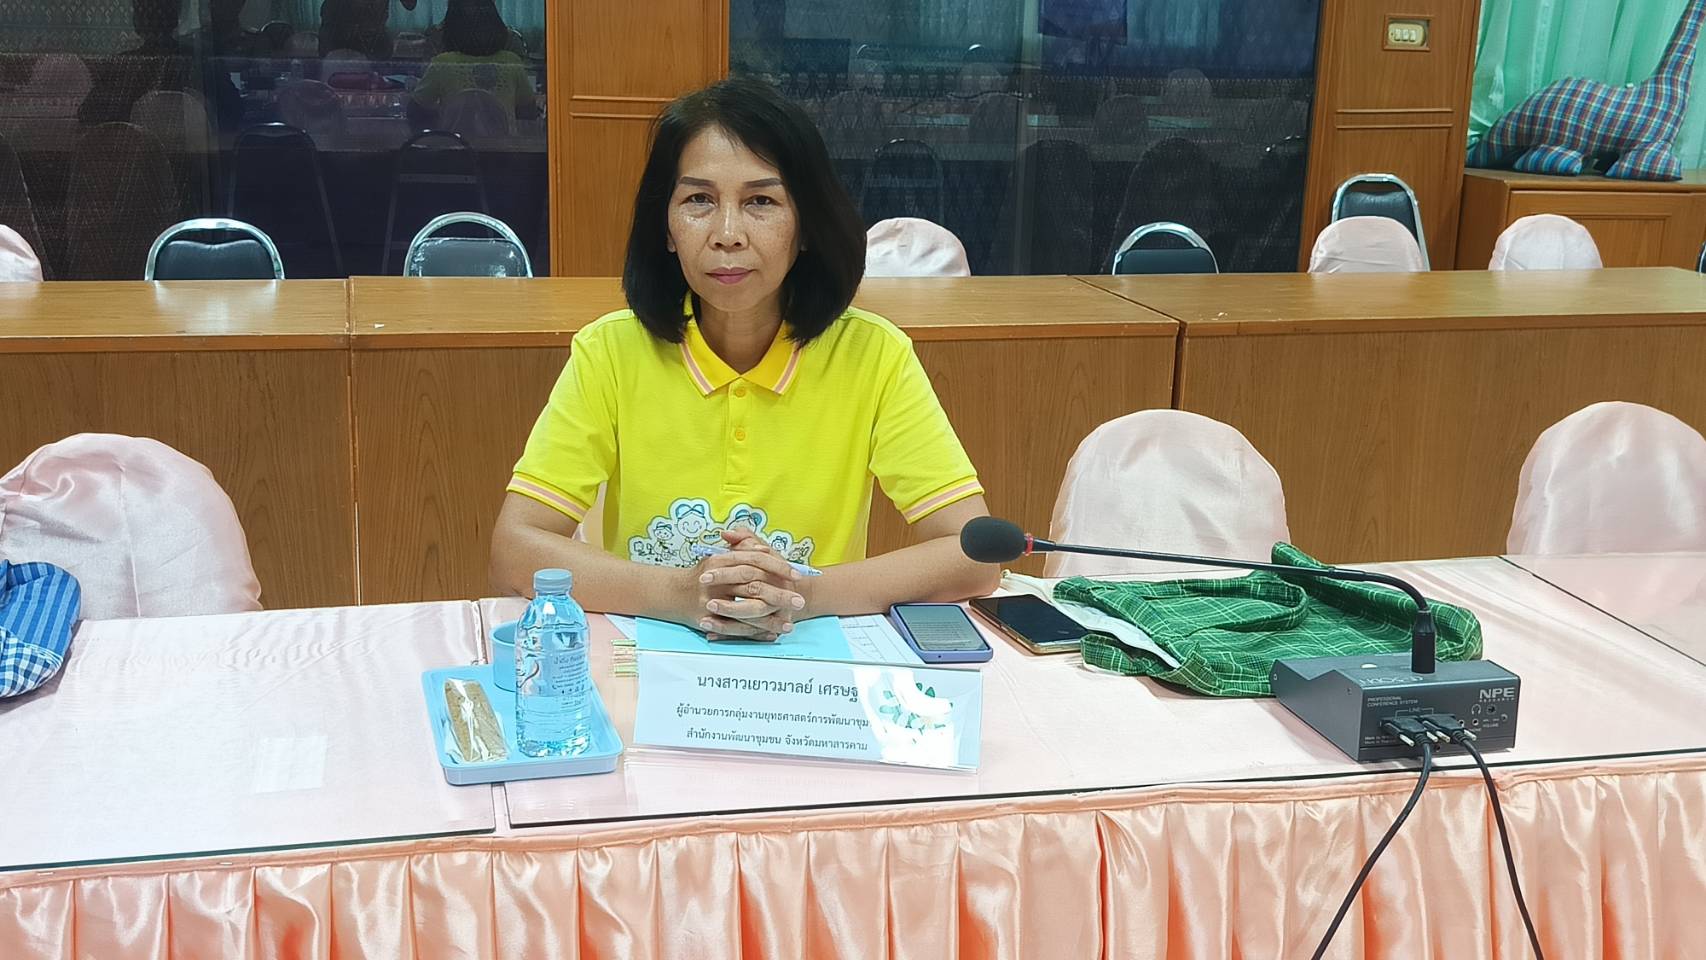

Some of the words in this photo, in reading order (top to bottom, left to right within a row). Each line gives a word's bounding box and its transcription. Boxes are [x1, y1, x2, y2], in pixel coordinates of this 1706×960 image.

[697, 675, 814, 695] นางสาวเยาวมาลย์
[1479, 687, 1515, 699] NPE
[676, 702, 872, 731] ผู้อำนวยการกลุ่มงานยุทธศาสตร์การพัฒนาชุม
[686, 727, 782, 747] สำนักงานพัฒนาชุมชน
[784, 735, 868, 751] จังหวัดมหาสารคาม
